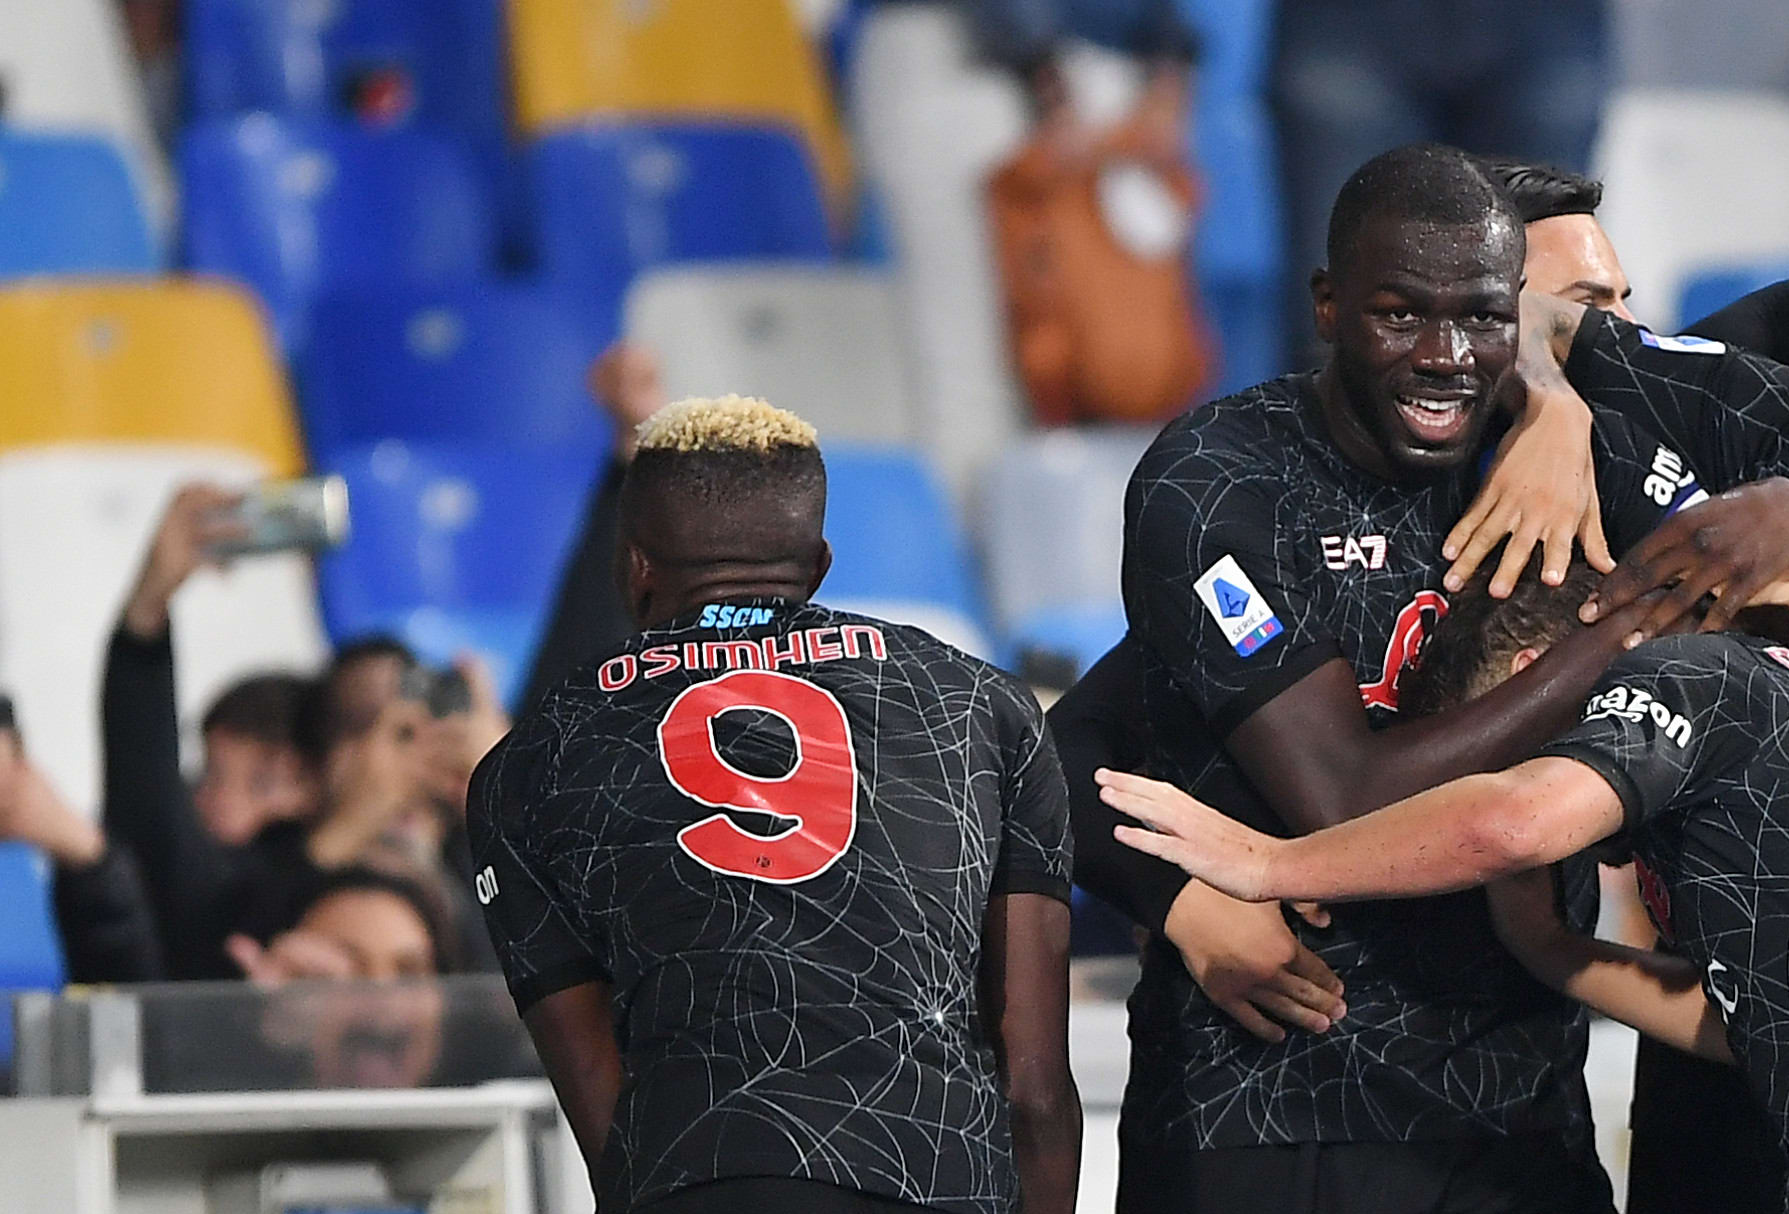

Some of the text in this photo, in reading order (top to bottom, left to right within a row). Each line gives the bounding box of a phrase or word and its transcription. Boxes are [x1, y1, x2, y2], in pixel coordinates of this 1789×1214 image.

[1320, 535, 1388, 570] EA7
[700, 604, 775, 629] SSCN
[1231, 613, 1258, 639] SERIE
[598, 624, 888, 692] OSIMHEN
[657, 669, 858, 884] 9
